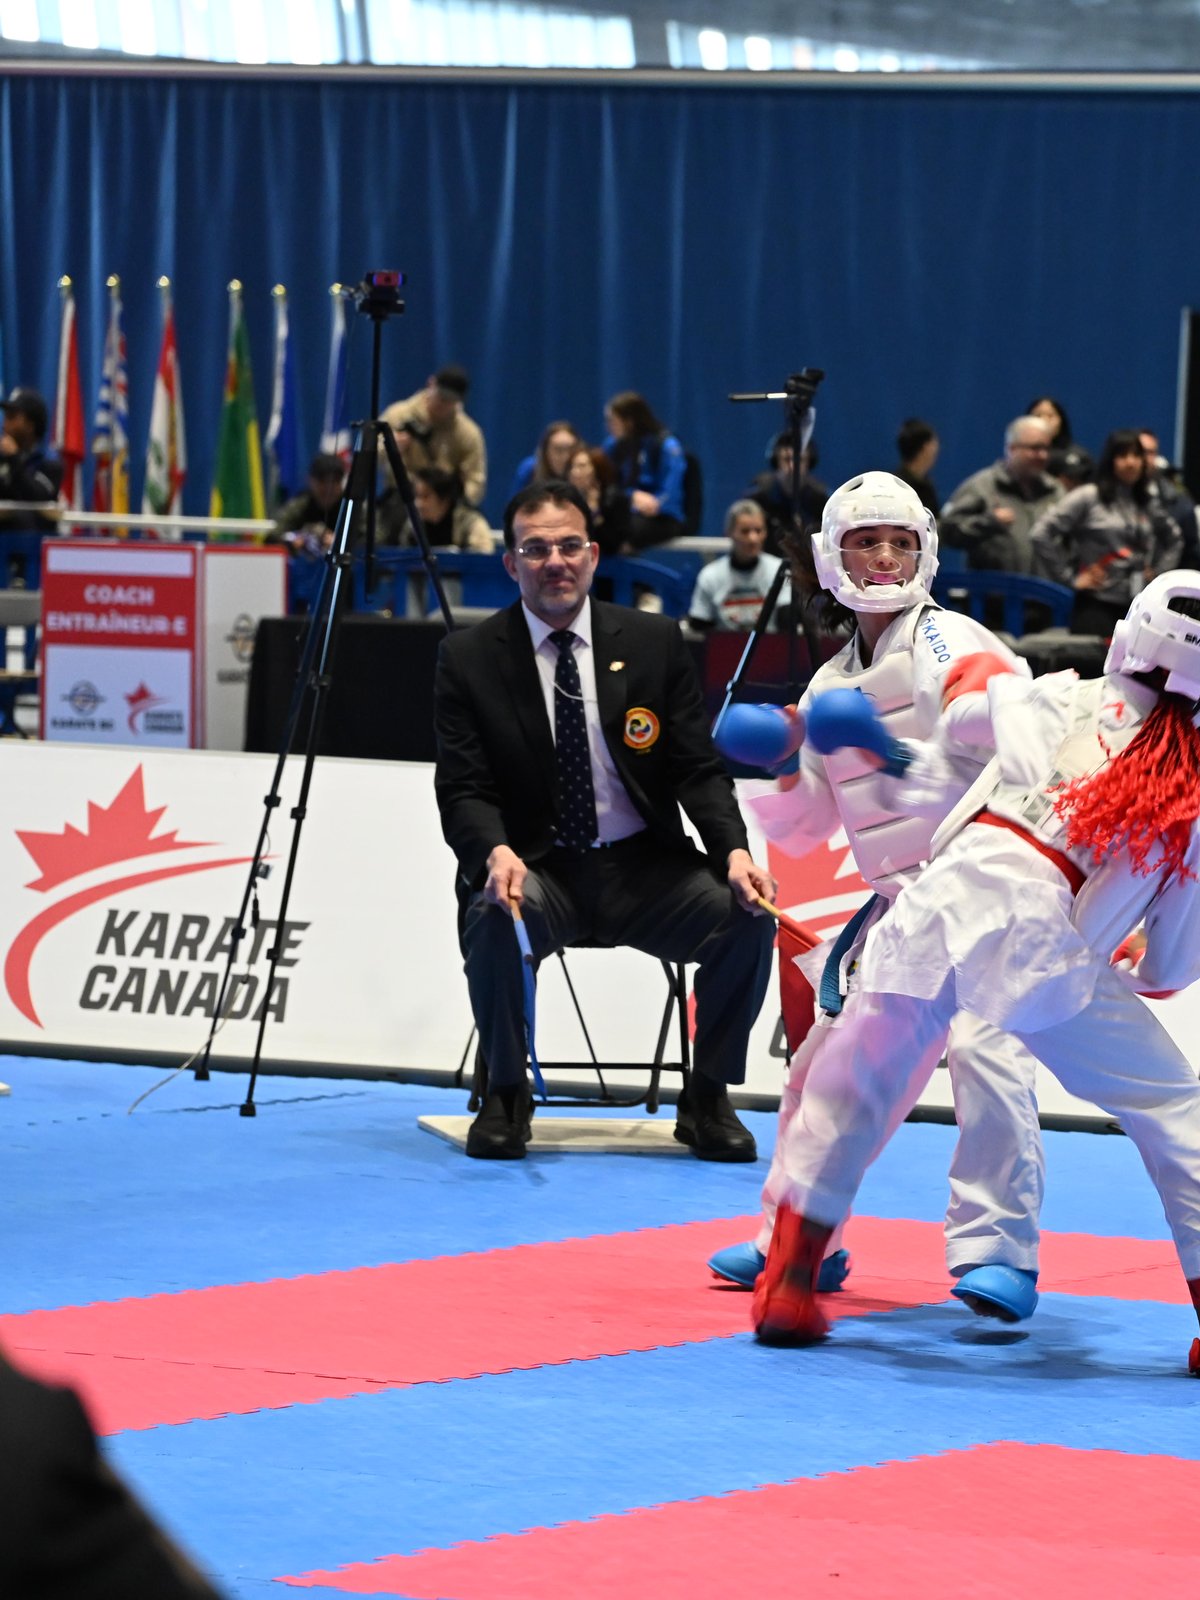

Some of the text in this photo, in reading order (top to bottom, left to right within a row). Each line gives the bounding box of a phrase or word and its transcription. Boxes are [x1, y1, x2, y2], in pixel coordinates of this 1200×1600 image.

[84, 585, 155, 606] COACH
[96, 909, 311, 967] KARATE
[79, 965, 290, 1023] CANADA
